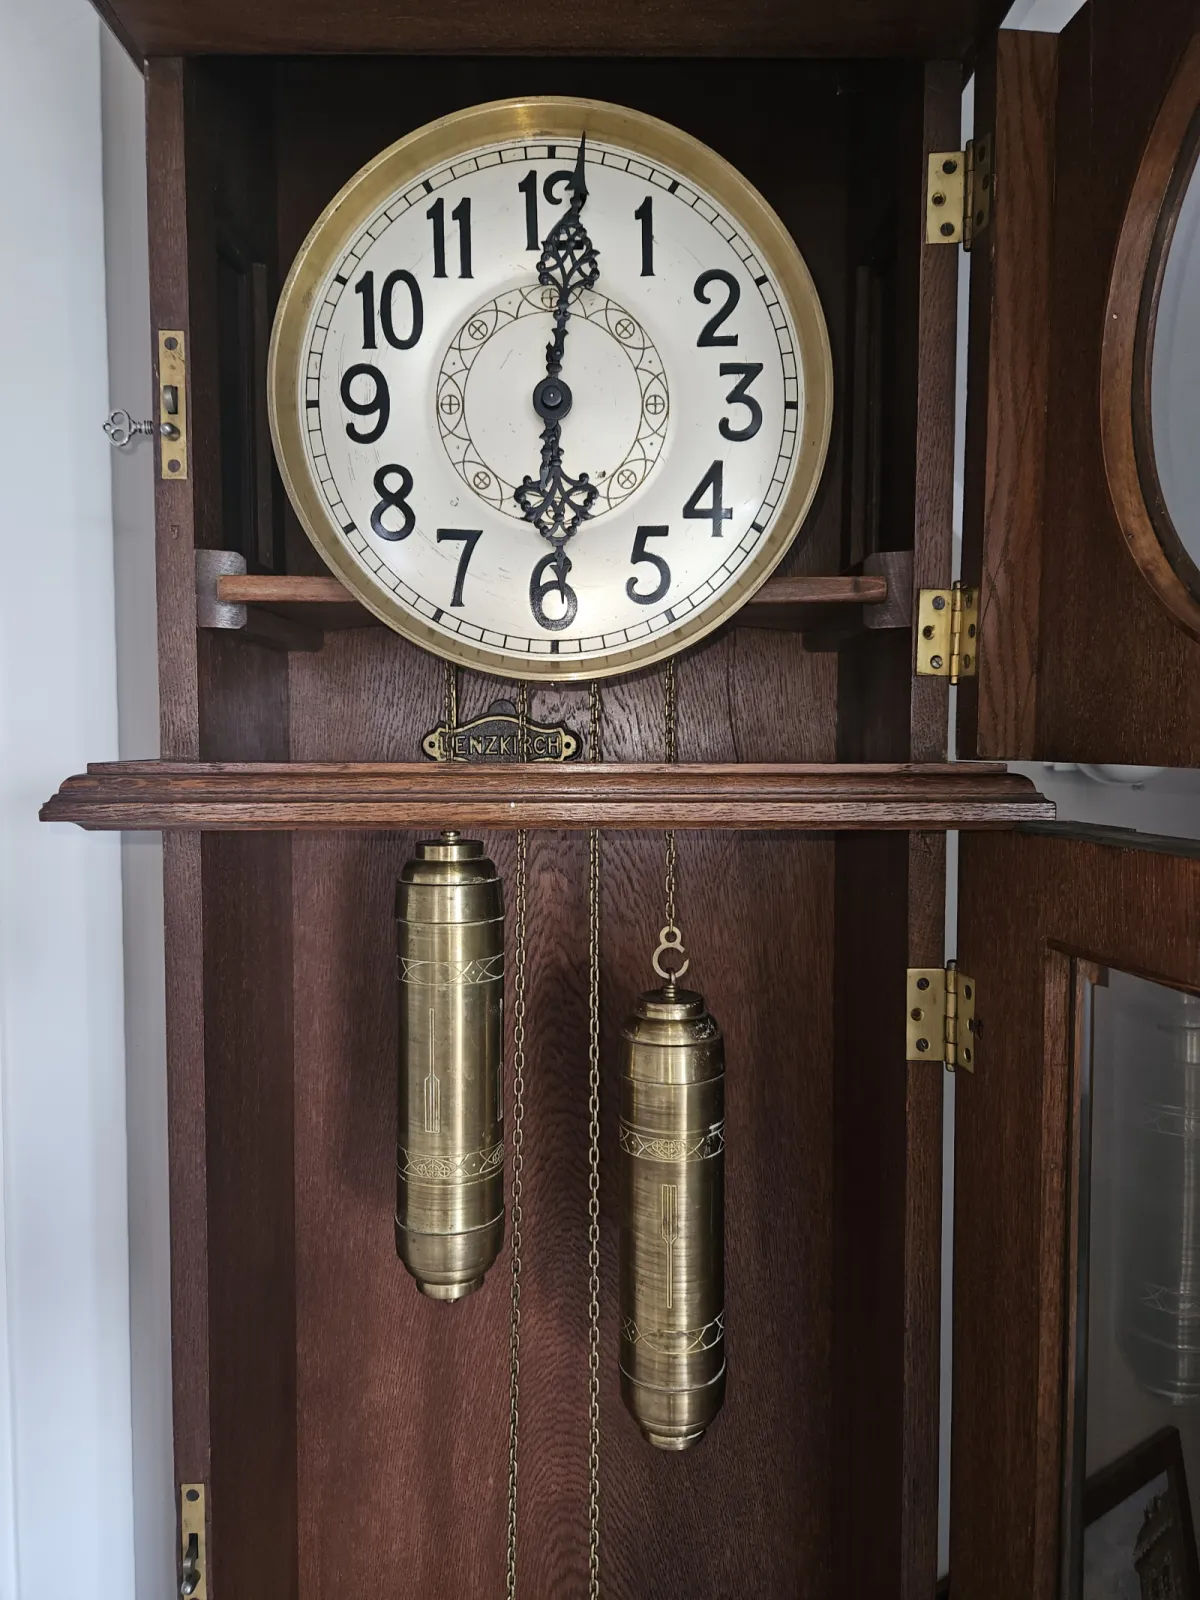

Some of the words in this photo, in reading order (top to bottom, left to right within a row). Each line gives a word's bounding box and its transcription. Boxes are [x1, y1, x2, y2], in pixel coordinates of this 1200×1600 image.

[427, 197, 474, 279] 11
[634, 195, 656, 277] 1
[354, 269, 424, 350] 10
[692, 268, 741, 348] 2
[340, 362, 391, 445] 9
[718, 362, 764, 442] 3
[370, 463, 416, 542] 8
[682, 459, 734, 537] 4
[436, 528, 484, 608] 7
[529, 552, 578, 631] 6
[626, 525, 672, 605] 5
